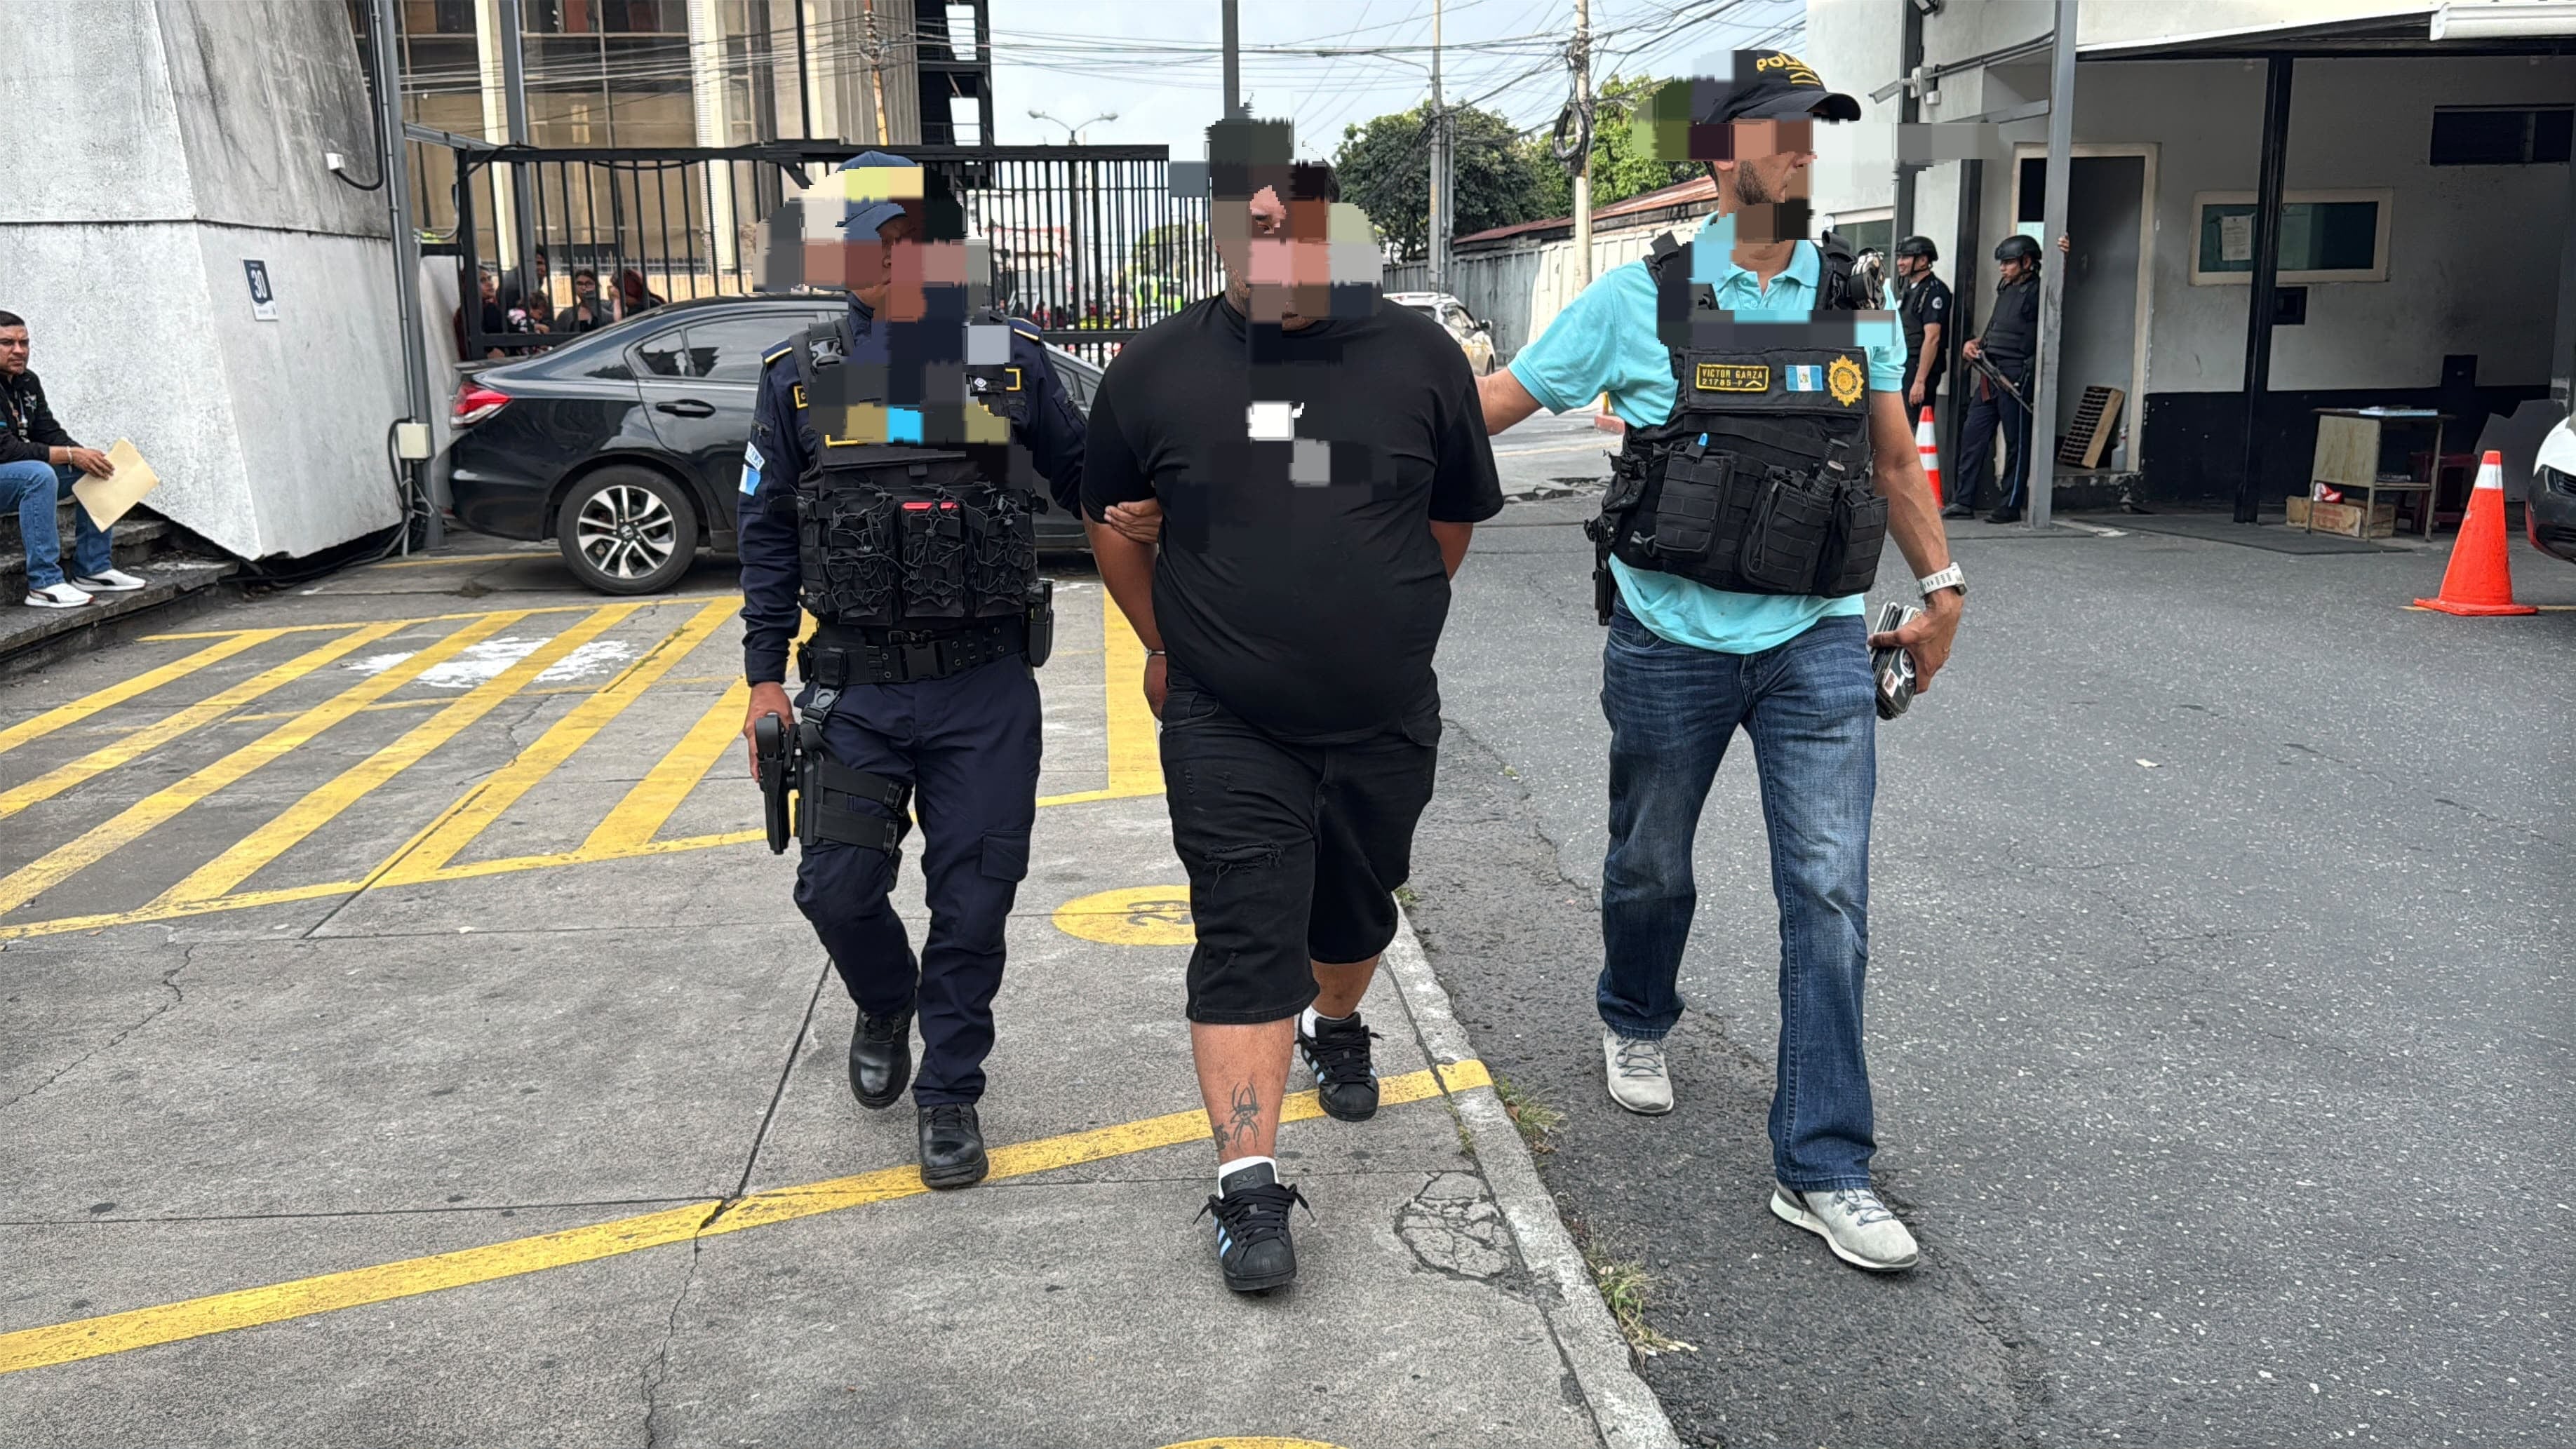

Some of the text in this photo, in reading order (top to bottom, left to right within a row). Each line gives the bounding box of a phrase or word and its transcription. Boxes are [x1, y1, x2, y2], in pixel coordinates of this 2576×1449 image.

[250, 269, 267, 299] 30
[1702, 369, 1763, 379] VICTOR GARZA
